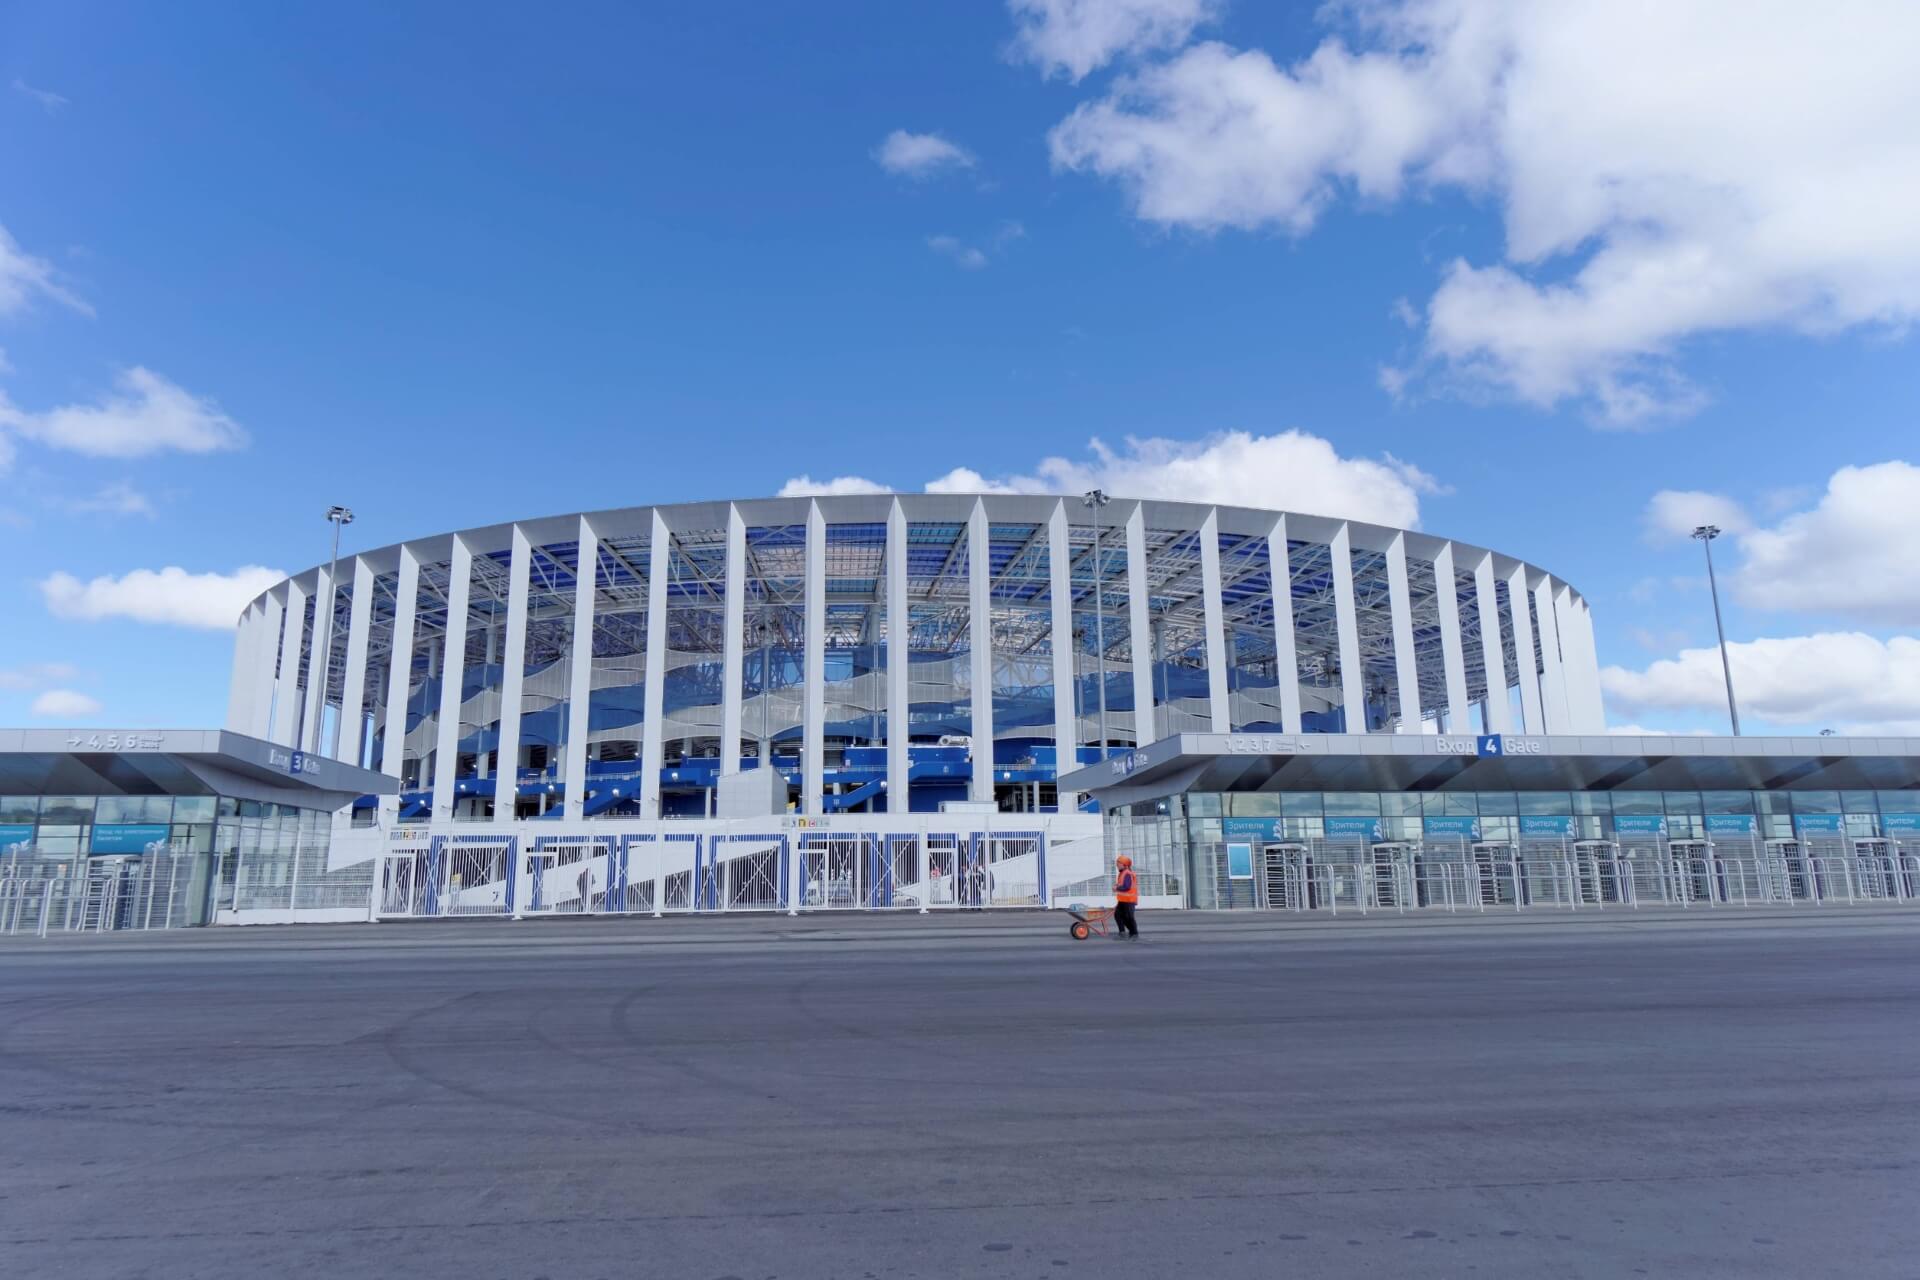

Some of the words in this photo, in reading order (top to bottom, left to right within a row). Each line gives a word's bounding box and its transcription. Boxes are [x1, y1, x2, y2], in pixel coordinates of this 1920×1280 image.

[126, 735, 138, 749] 6
[1264, 739, 1272, 751] 7
[1436, 738, 1475, 755] Вход
[1485, 738, 1497, 753] 4
[1505, 738, 1540, 753] Gate
[293, 754, 303, 771] 3
[1228, 821, 1264, 830] Зрители
[1330, 820, 1365, 830] Зрители
[1428, 820, 1463, 830] Зрители
[1525, 819, 1558, 828] Зрители
